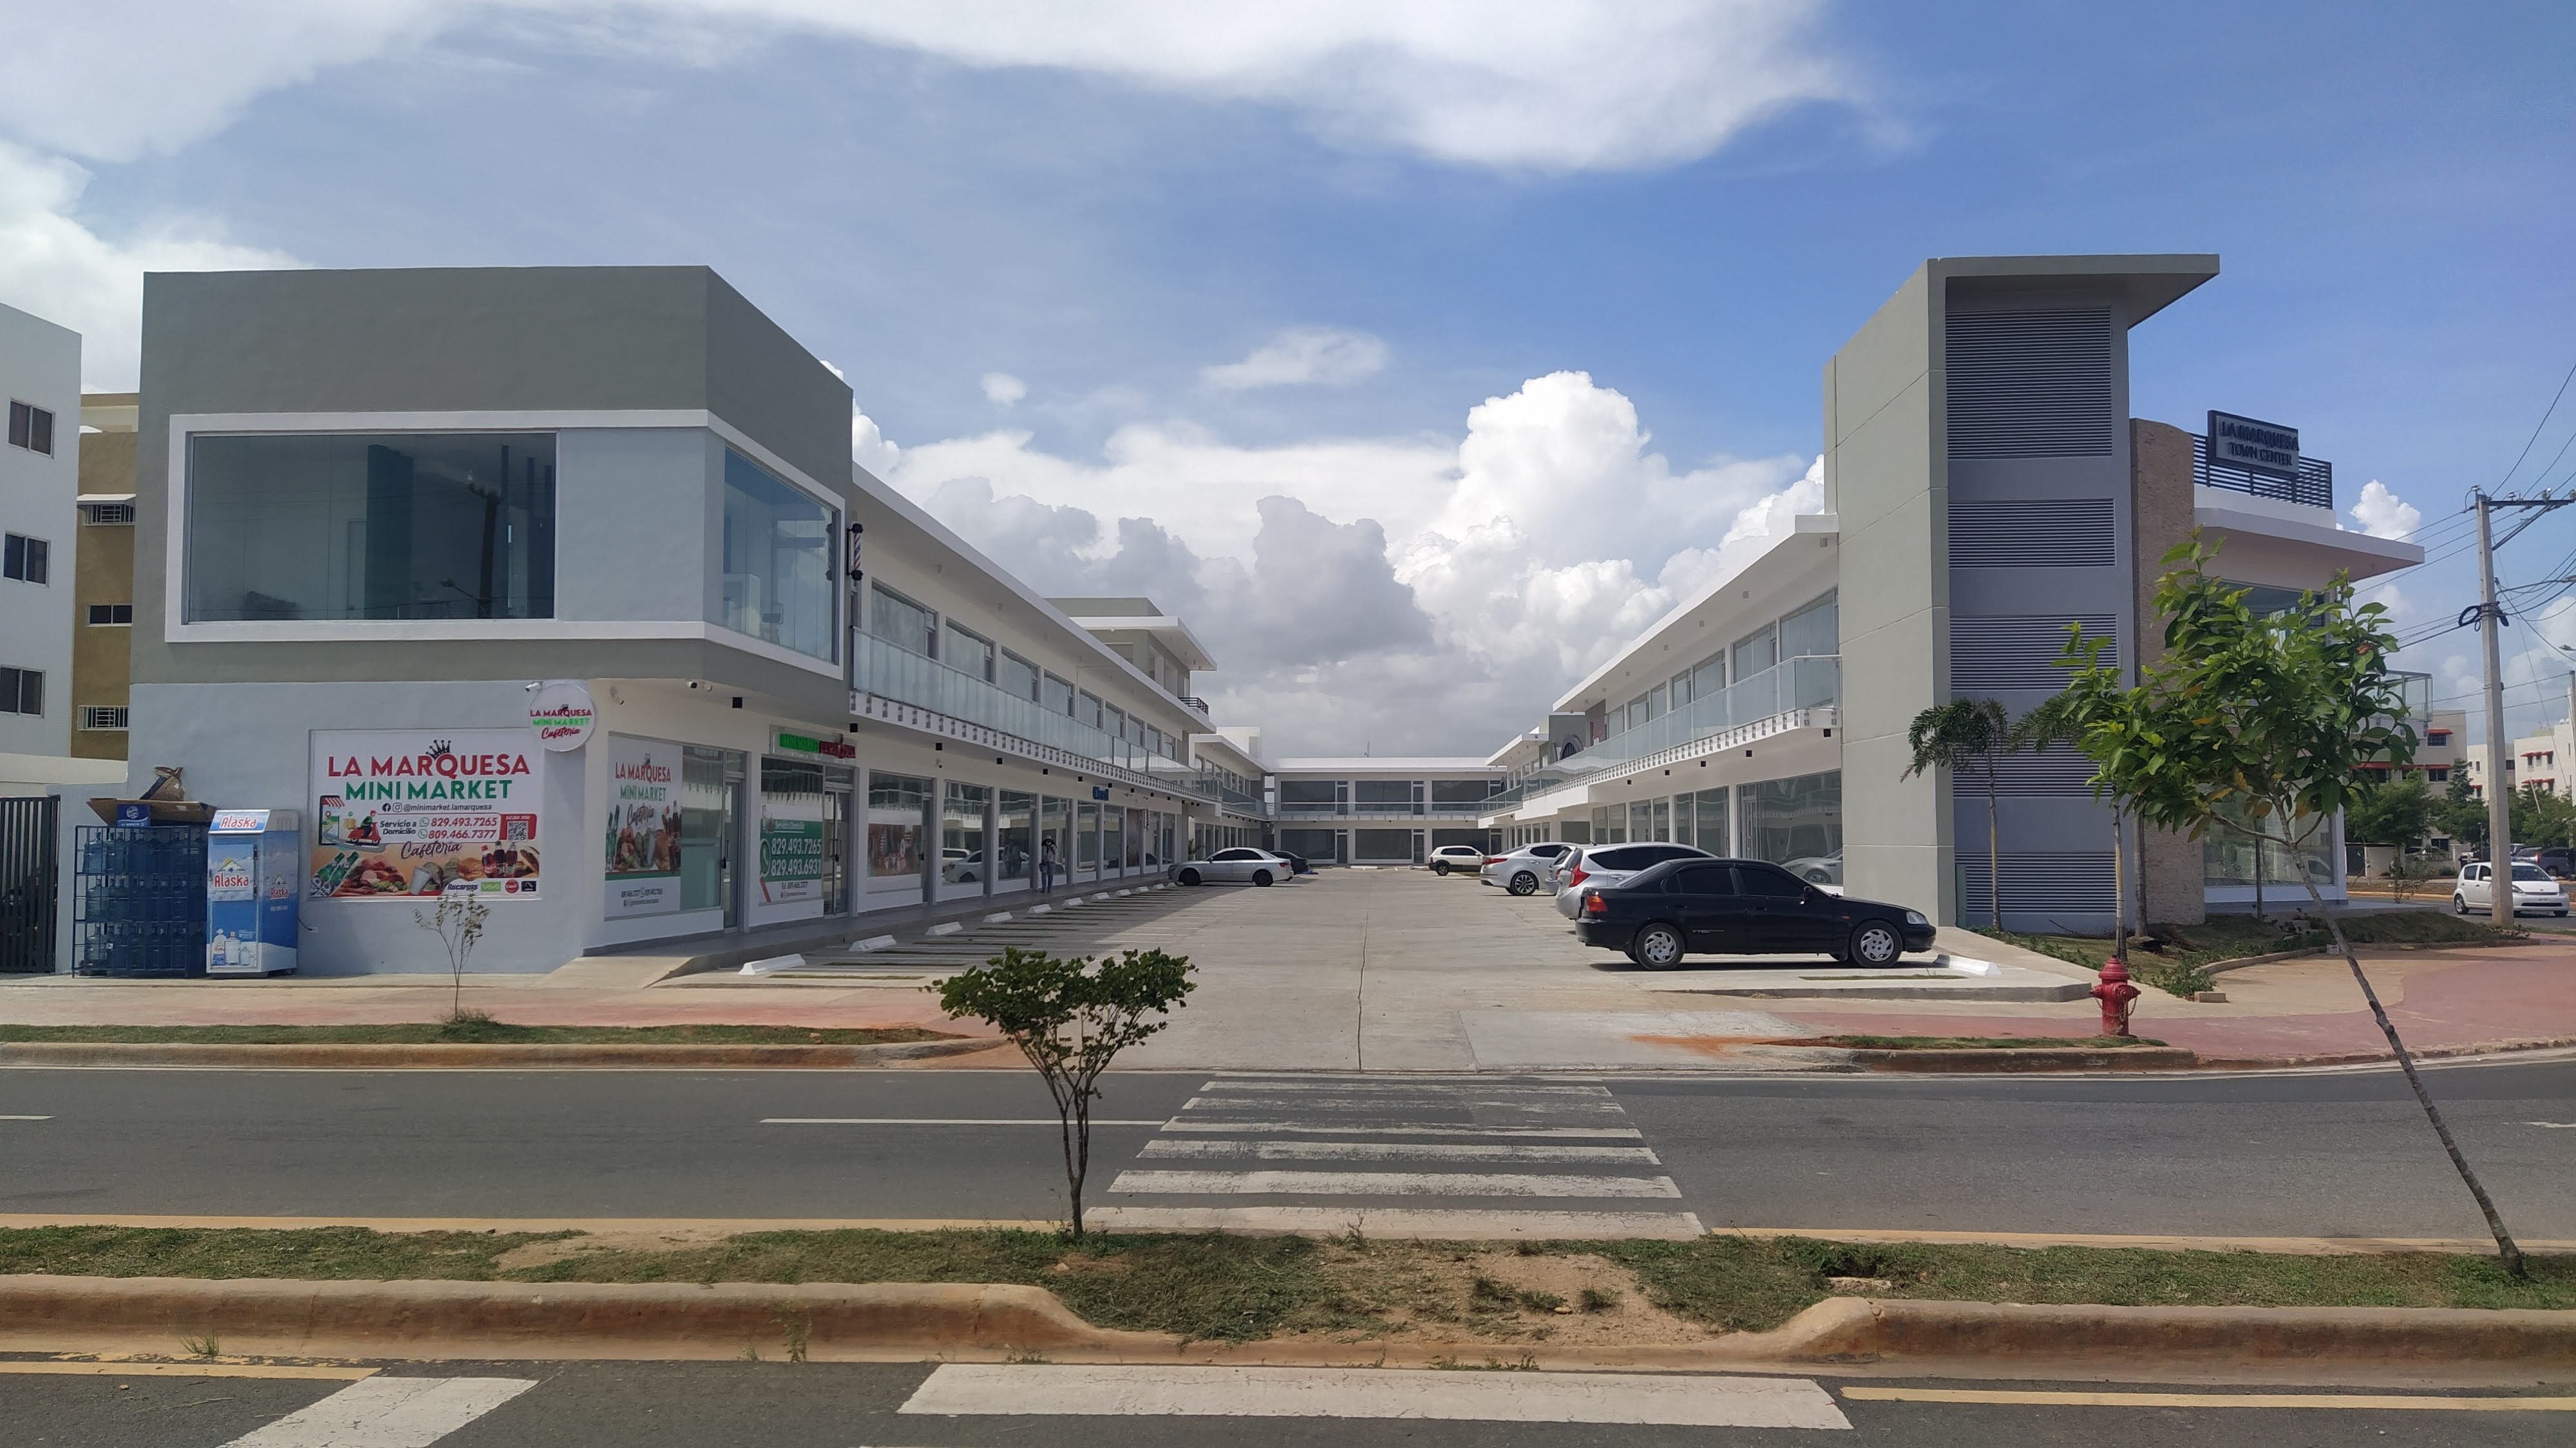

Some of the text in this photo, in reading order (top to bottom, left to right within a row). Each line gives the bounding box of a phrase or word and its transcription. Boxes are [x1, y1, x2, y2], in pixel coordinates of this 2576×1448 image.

[2221, 421, 2299, 451] LA MARQUESA
[2230, 442, 2293, 466] TOWN CENTER
[328, 753, 531, 779] LA MARQUESA
[616, 762, 671, 783] LA MARQUESA
[345, 779, 513, 800] MINI MARKET
[620, 785, 667, 802] MINI MARKET
[403, 804, 491, 813] @minimarket.lamarquesa
[220, 817, 256, 828] Alaska
[431, 817, 497, 827] 829.493.7265
[428, 830, 497, 839] 809.466.7377
[772, 838, 821, 855] 829.493.7265
[772, 859, 821, 876] 829.493.6931
[214, 872, 249, 887] Alaska
